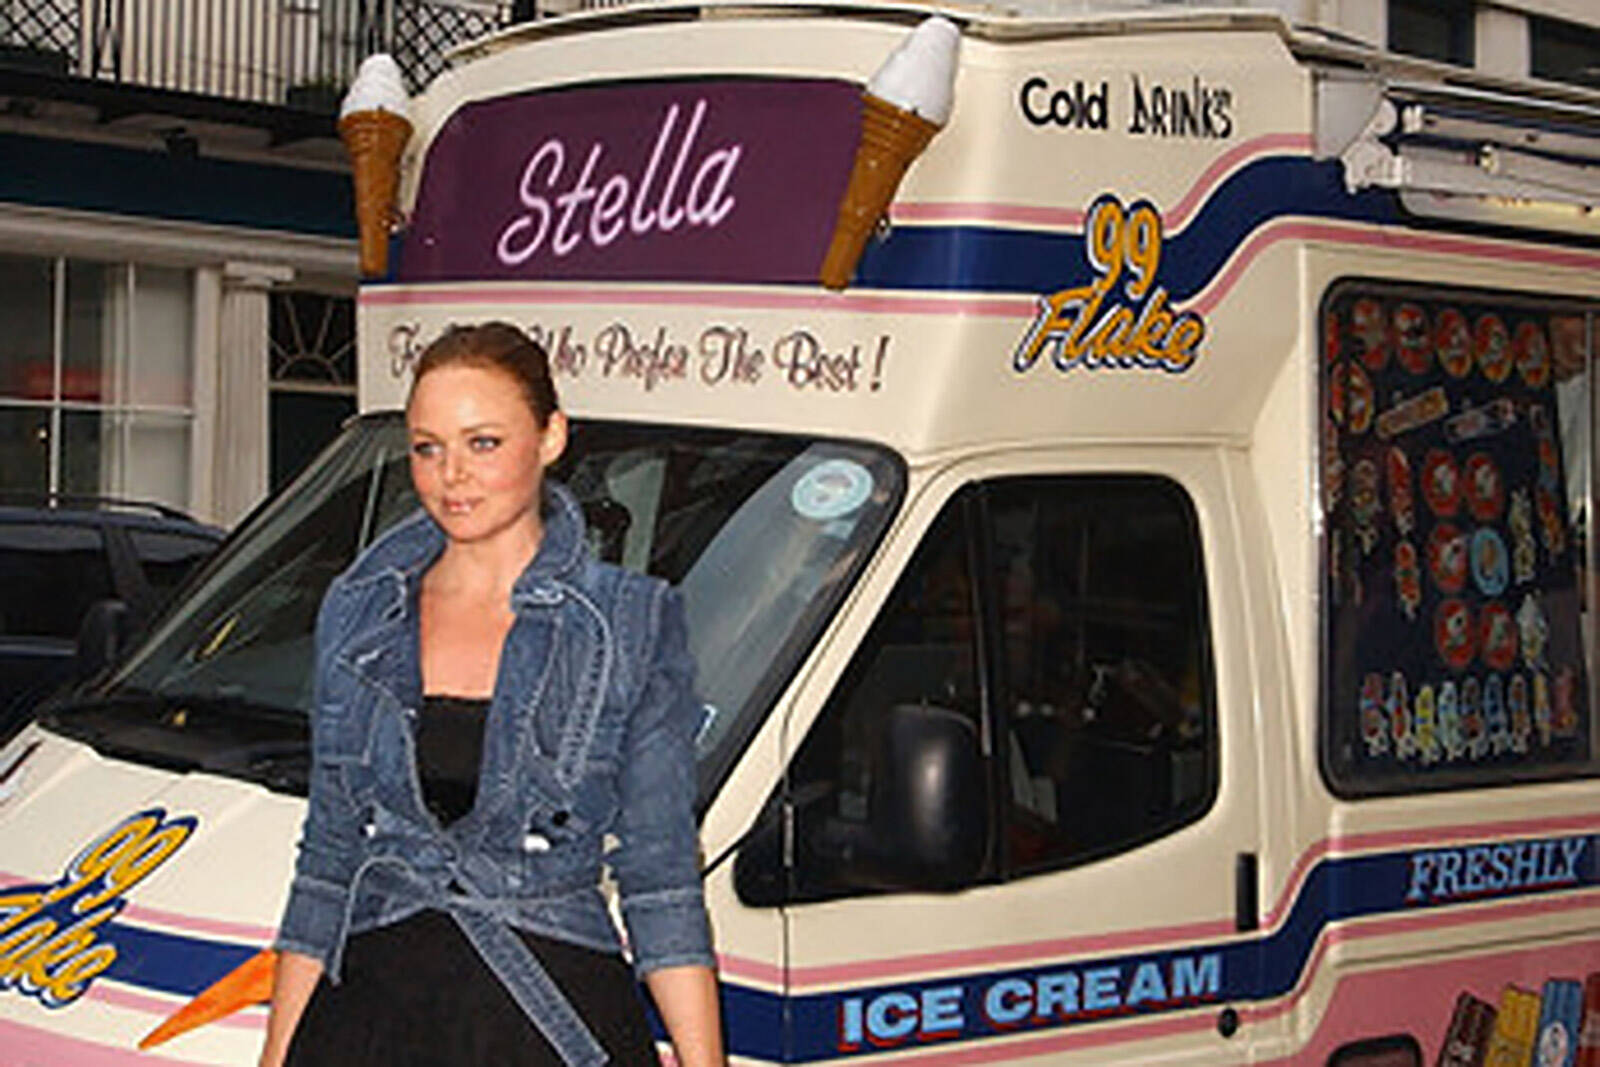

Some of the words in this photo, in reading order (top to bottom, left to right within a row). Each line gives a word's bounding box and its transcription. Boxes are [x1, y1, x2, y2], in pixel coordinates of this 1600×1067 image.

[1020, 77, 1109, 130] Cold
[1127, 73, 1232, 139] DRINKS
[496, 99, 742, 266] Stella
[1085, 193, 1163, 300] 99
[699, 326, 765, 386] The
[1013, 286, 1206, 373] Flake
[48, 806, 199, 914] 99
[1405, 837, 1587, 906] FRESHLY
[838, 986, 965, 1052] ICE
[983, 953, 1222, 1030] CREAM
